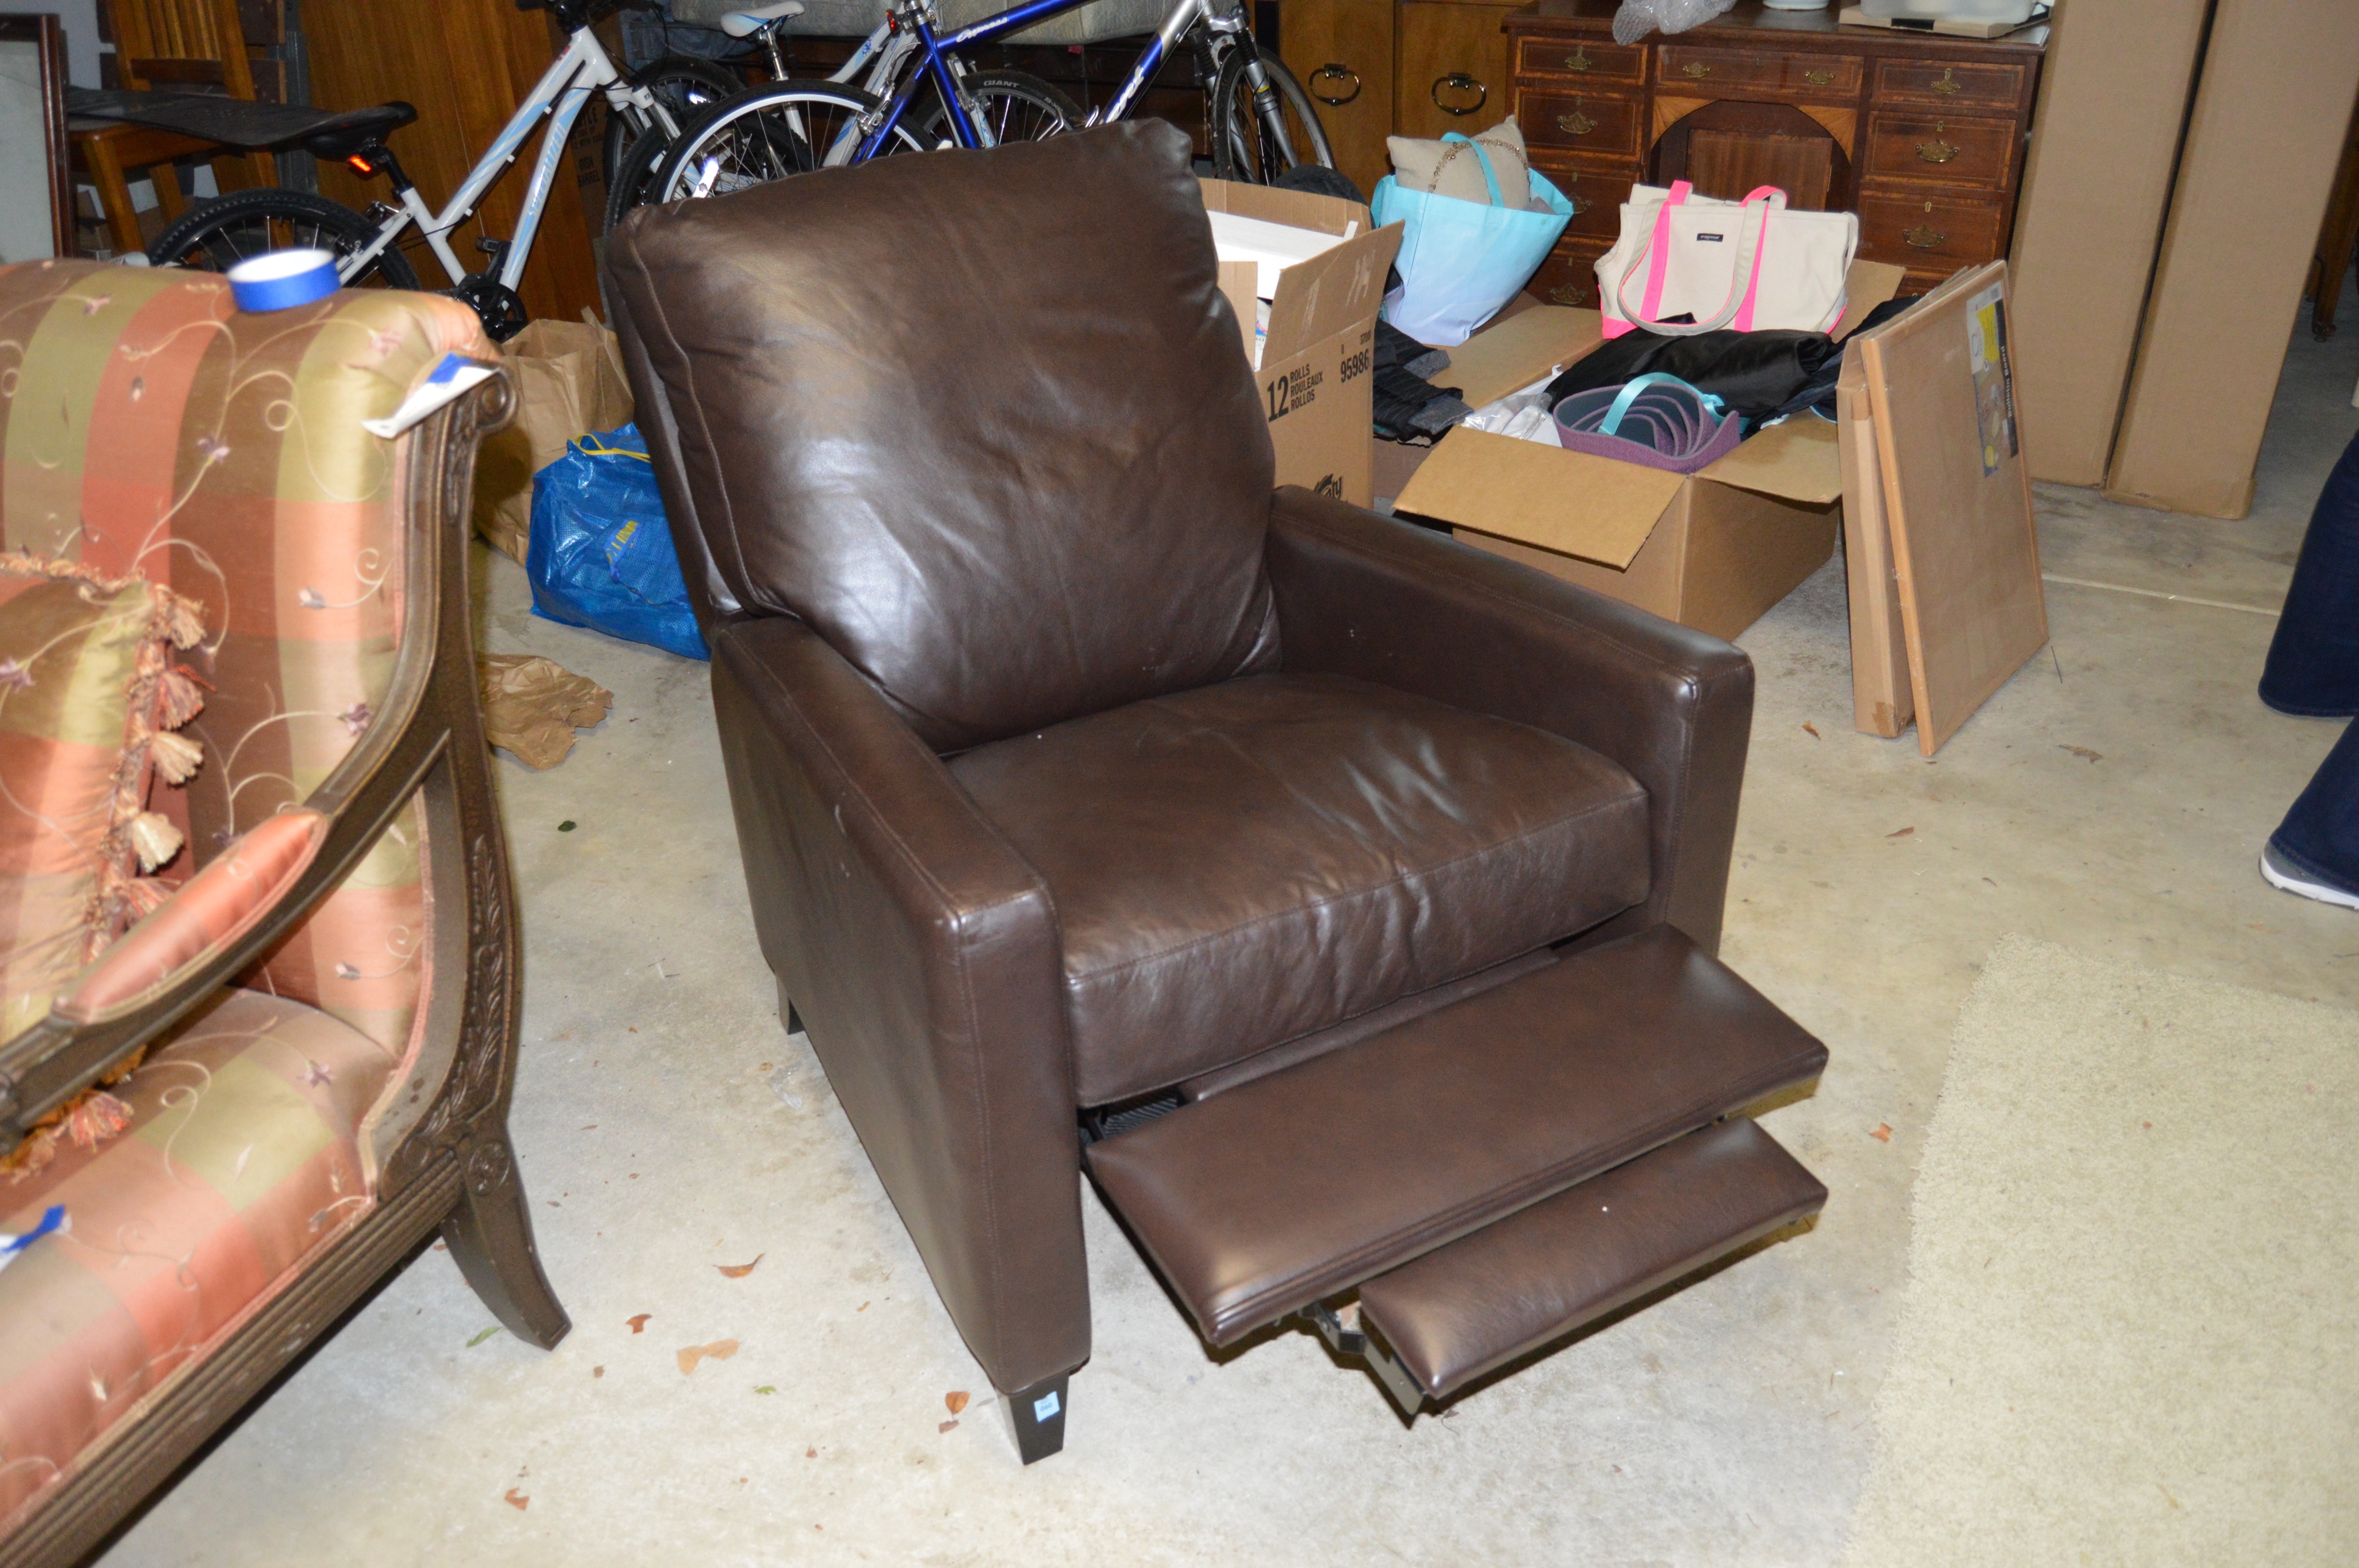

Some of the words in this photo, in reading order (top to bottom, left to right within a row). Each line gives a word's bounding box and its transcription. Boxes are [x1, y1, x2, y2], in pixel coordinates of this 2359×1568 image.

[956, 16, 1010, 42] Cypress
[983, 79, 1020, 88] GIANT
[579, 155, 594, 171] DISH
[1341, 349, 1369, 383] 95986
[2000, 345, 2009, 376] Board
[1290, 364, 1310, 384] ROLLS
[1290, 371, 1323, 398] ROULEAUX
[1267, 375, 1289, 422] 12
[1290, 389, 1315, 411] ROLLOS
